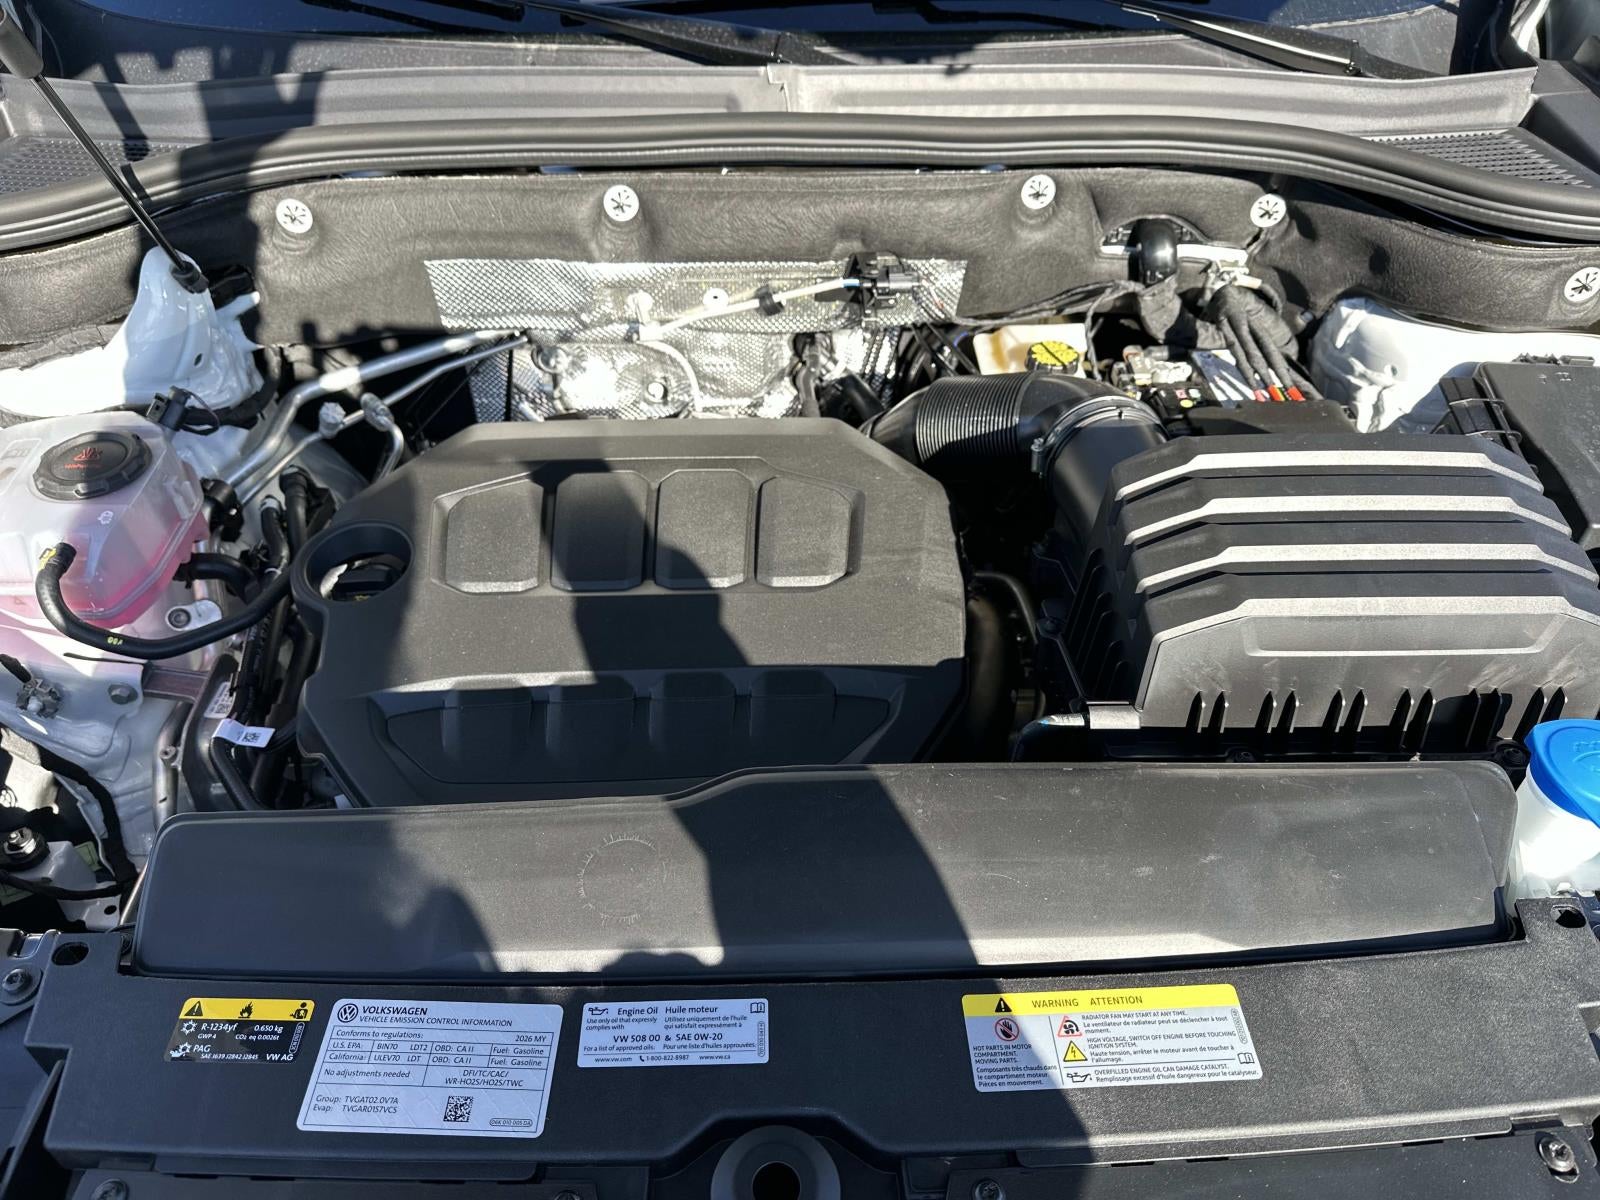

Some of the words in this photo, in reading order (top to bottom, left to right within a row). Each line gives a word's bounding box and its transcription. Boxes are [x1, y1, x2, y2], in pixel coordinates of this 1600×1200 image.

[1032, 998, 1079, 1008] WARNING
[1090, 995, 1143, 1006] ATTENTION
[362, 1005, 428, 1016] VOLKSWAGEN
[617, 1007, 645, 1017] Engine
[646, 1006, 659, 1015] Oil
[665, 1005, 687, 1014] Huile
[688, 1005, 718, 1014] moteur
[359, 1015, 389, 1023] VEHICLE
[389, 1016, 425, 1024] EMISSION
[426, 1017, 460, 1025] CONTROL
[461, 1018, 513, 1027] INFORMATION
[201, 1022, 238, 1032] R-1234yf
[254, 1024, 273, 1032] 0.650
[274, 1025, 284, 1033] kg
[663, 1023, 674, 1031] qui
[336, 1028, 370, 1037] Conforms
[372, 1030, 380, 1038] to
[380, 1031, 424, 1040] regulations:
[515, 1034, 533, 1042] 2026
[613, 1034, 629, 1043] VW
[630, 1034, 647, 1043] 508
[648, 1034, 661, 1042] 00
[675, 1033, 692, 1041] SAE
[693, 1032, 723, 1041] 0W-20
[1208, 1030, 1237, 1038] TOUCHING
[193, 1044, 212, 1052] PAG
[332, 1041, 346, 1049] U.S.
[409, 1043, 428, 1051] LDT2
[434, 1044, 454, 1052] OBD:
[456, 1045, 467, 1053] CA
[493, 1046, 510, 1054] Fuel:
[513, 1047, 544, 1055] Gasoline
[615, 1044, 642, 1052] approved
[266, 1053, 280, 1061] VW
[280, 1053, 294, 1061] AG
[328, 1052, 365, 1061] California:
[373, 1054, 400, 1062] ULEV70
[453, 1056, 464, 1064] CA
[974, 1057, 999, 1065] MOVING
[490, 1057, 507, 1066] Fuel:
[510, 1058, 542, 1067] Gasoline
[324, 1068, 335, 1076] No
[335, 1069, 382, 1078] adjustments
[382, 1070, 411, 1078] needed
[463, 1069, 509, 1078] DFI/TC/CAC/
[976, 1065, 1011, 1073] Composants
[1094, 1068, 1129, 1076] OVERFILLED
[1175, 1064, 1200, 1072] DAMAGE
[984, 1073, 1026, 1081] compartiment
[1207, 1071, 1221, 1079] pour
[316, 1094, 341, 1103] Group:
[313, 1104, 333, 1112] Evap:
